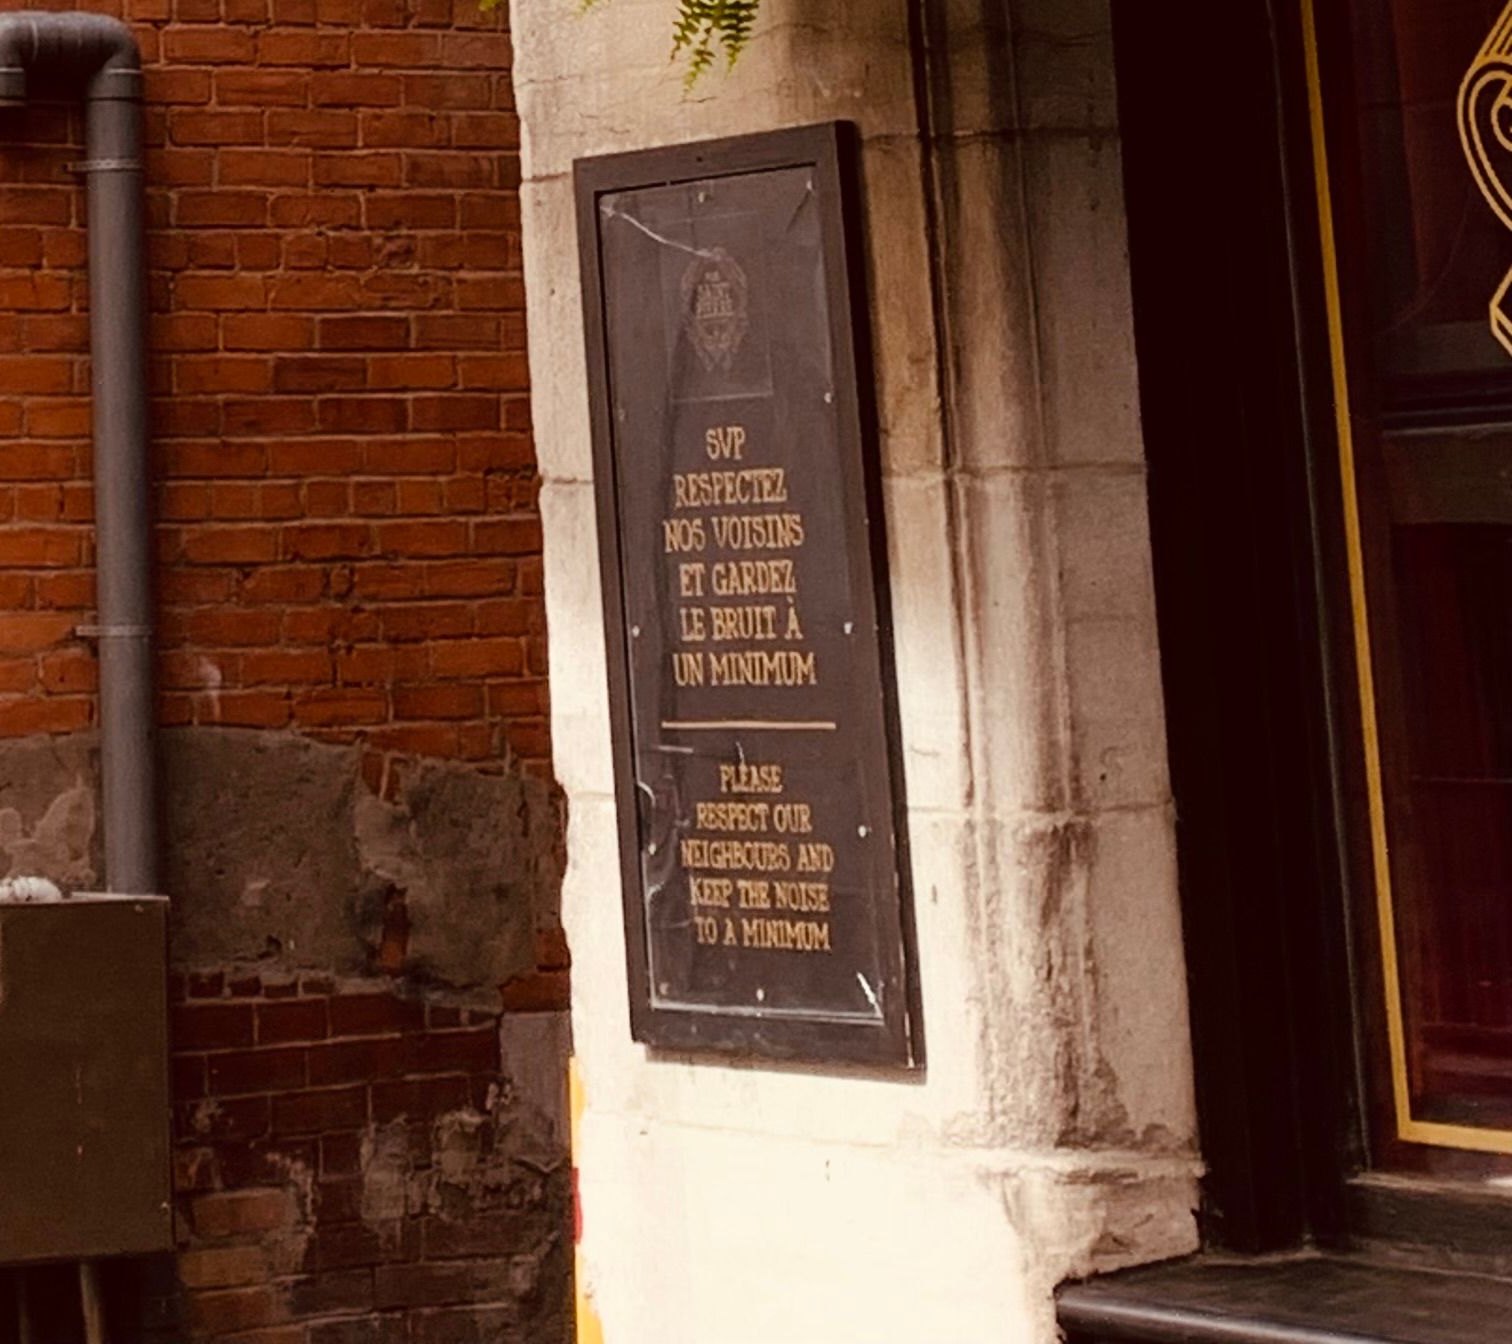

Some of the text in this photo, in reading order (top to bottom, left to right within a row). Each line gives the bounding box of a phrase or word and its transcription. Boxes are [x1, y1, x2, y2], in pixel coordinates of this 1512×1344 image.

[705, 426, 746, 460] SVP
[673, 468, 787, 508] RESPECTEZ
[663, 513, 804, 553] NOS VOISINS
[679, 559, 797, 597] ET GARDEZ
[680, 594, 804, 642] LE BRUIT À
[673, 651, 817, 686] UN MINIMUM
[719, 764, 783, 793] PLEASE
[696, 802, 813, 833] RESPECT OUR
[680, 839, 835, 873] NEIGHBOURS AND
[690, 875, 830, 912] KEEP THE NOISE
[694, 916, 832, 951] TO A MINIMUM
